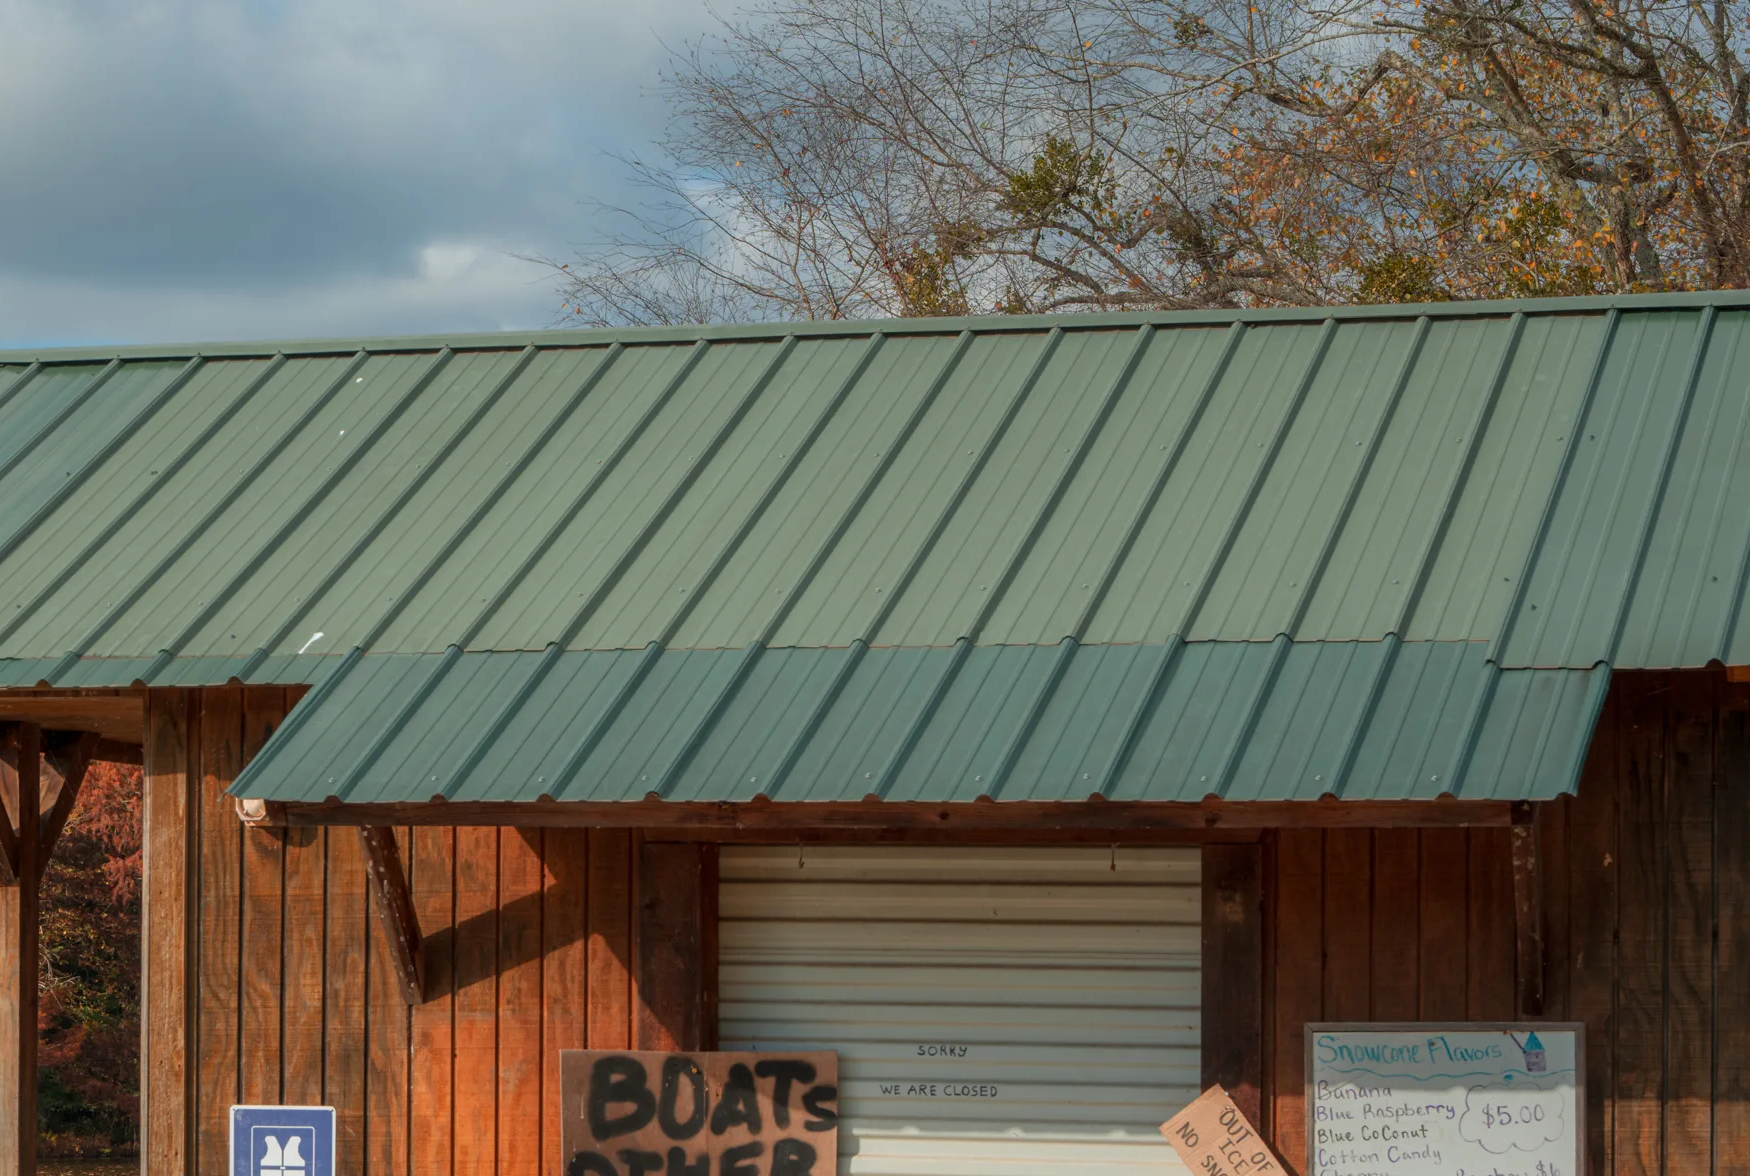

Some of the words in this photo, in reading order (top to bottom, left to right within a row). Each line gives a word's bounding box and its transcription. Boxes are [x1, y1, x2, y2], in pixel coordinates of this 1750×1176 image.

[917, 1045, 968, 1057] SORRY
[1318, 1035, 1422, 1064] Snowcone
[1427, 1036, 1503, 1064] Flavors
[880, 1084, 901, 1096] WE
[907, 1084, 937, 1097] ARE
[944, 1084, 998, 1098] CLOSED
[1318, 1080, 1393, 1101] Banana
[1316, 1105, 1355, 1121] Blue
[1363, 1103, 1456, 1123] Raspberry
[1482, 1103, 1545, 1129] $5.00
[1175, 1121, 1200, 1148] NO
[1219, 1106, 1254, 1144] OUT
[1250, 1151, 1275, 1173] OF
[1318, 1128, 1355, 1144] Blue
[1218, 1137, 1250, 1175] ICE
[1319, 1148, 1380, 1167] Cotton
[1387, 1144, 1442, 1165] Candy
